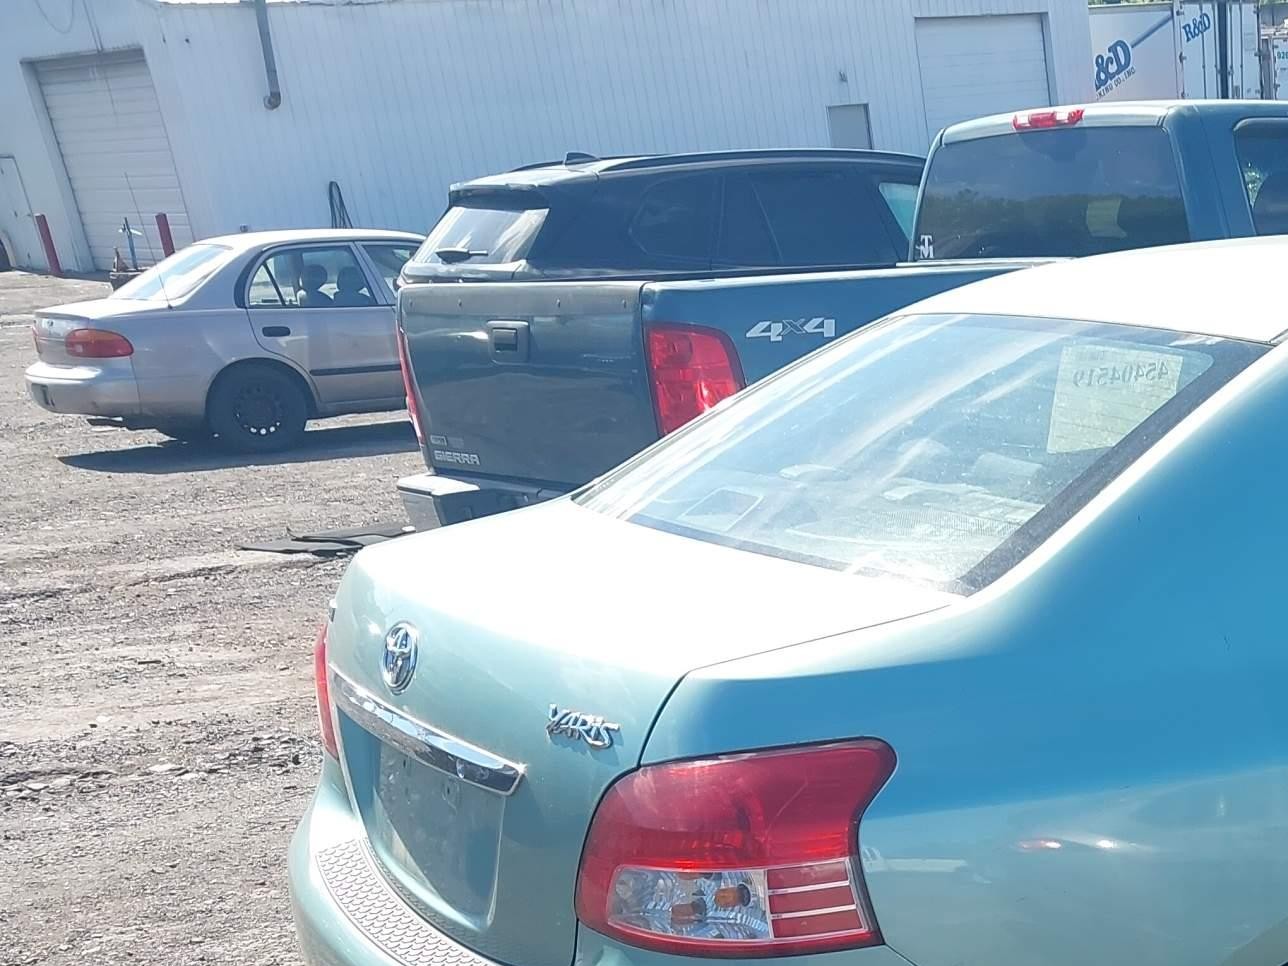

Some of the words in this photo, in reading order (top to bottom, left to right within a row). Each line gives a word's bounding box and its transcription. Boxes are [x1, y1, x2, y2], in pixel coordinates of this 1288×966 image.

[1182, 12, 1211, 43] R&D
[1095, 39, 1131, 92] &D
[434, 449, 481, 466] SIERRA
[545, 703, 620, 748] YARIS
